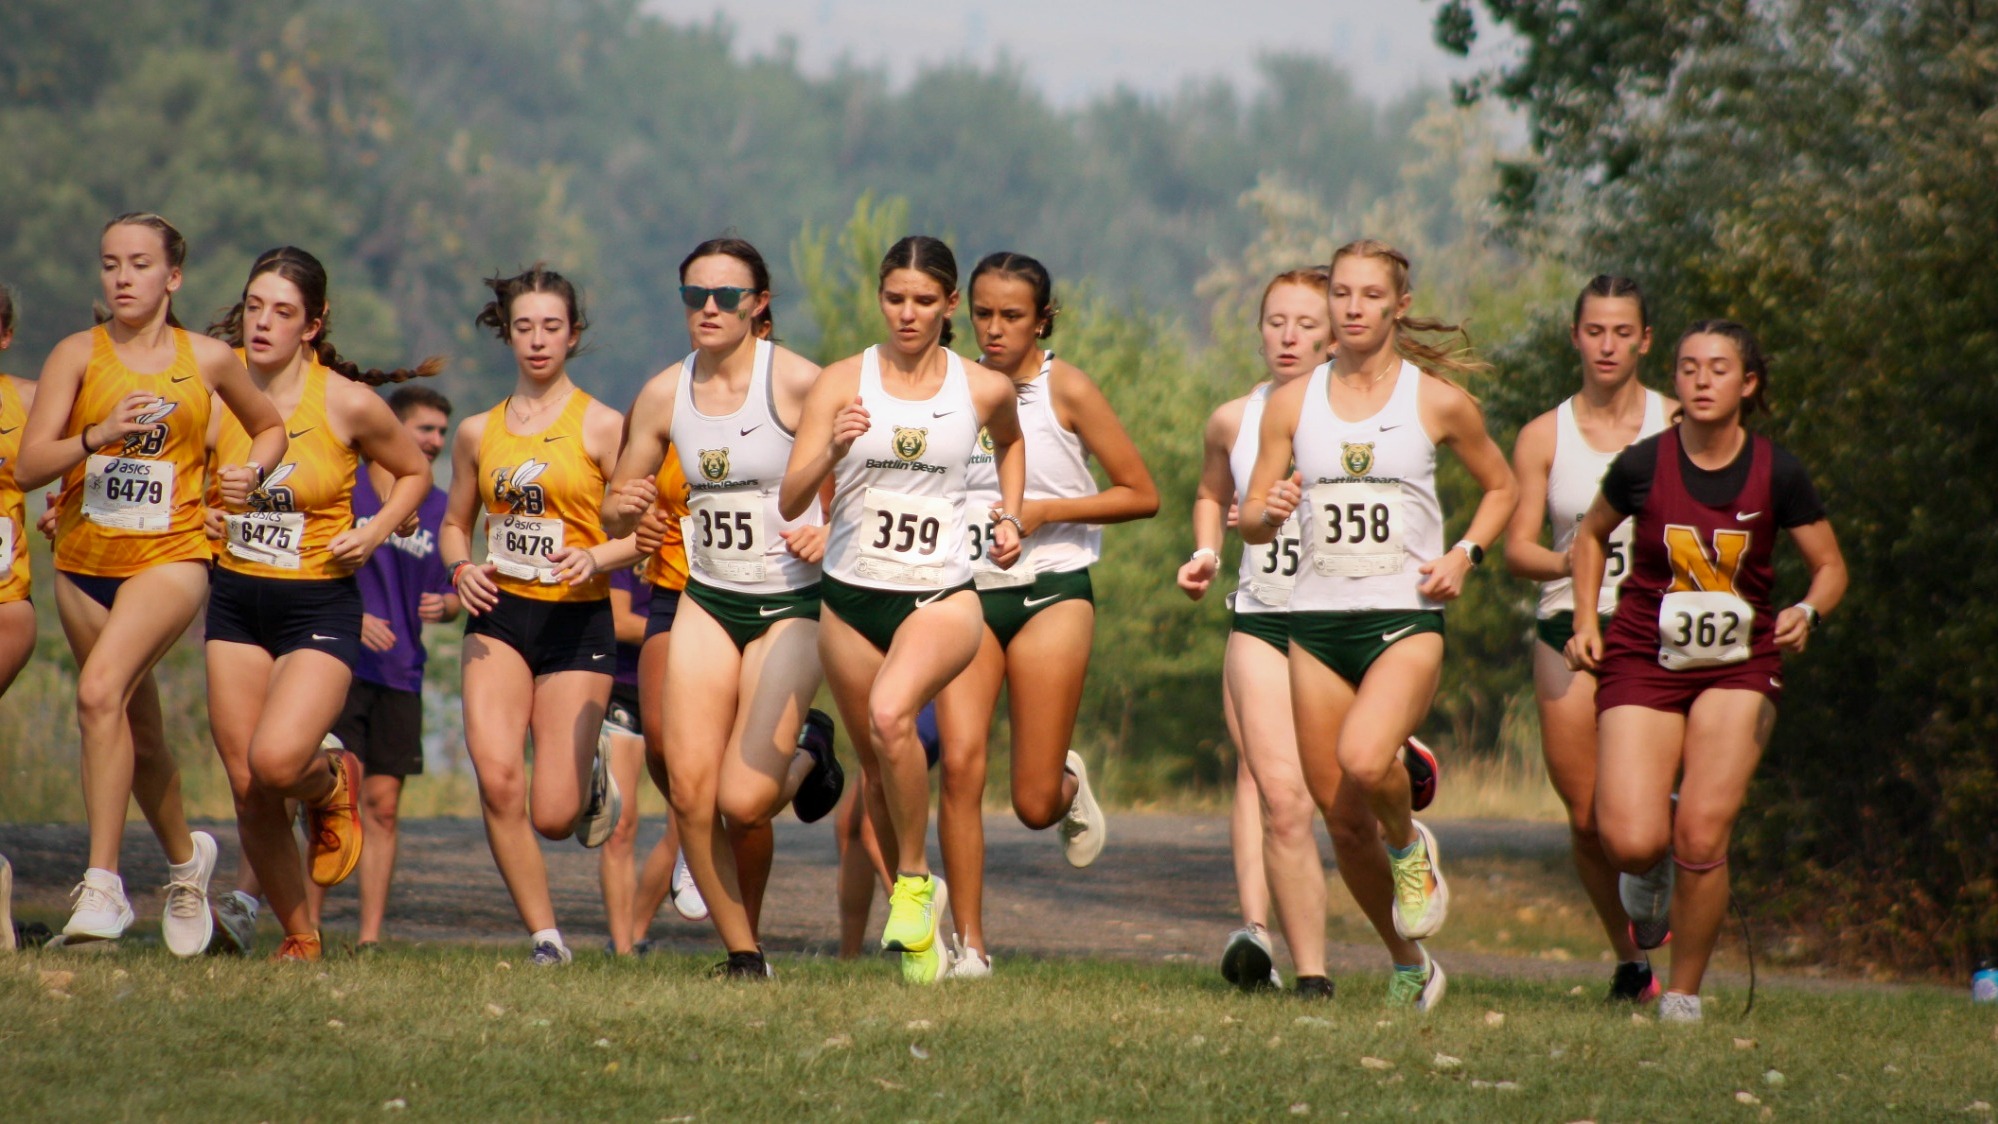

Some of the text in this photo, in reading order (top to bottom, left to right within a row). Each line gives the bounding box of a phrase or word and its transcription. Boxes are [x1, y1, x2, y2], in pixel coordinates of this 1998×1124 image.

[106, 476, 163, 505] 6479
[241, 521, 293, 549] 6475
[699, 508, 753, 551] 355
[872, 509, 940, 555] 359
[1323, 502, 1390, 544] 358
[506, 531, 554, 558] 6478
[1262, 537, 1300, 577] 35
[1663, 524, 1750, 598] N
[1673, 610, 1740, 648] 362
